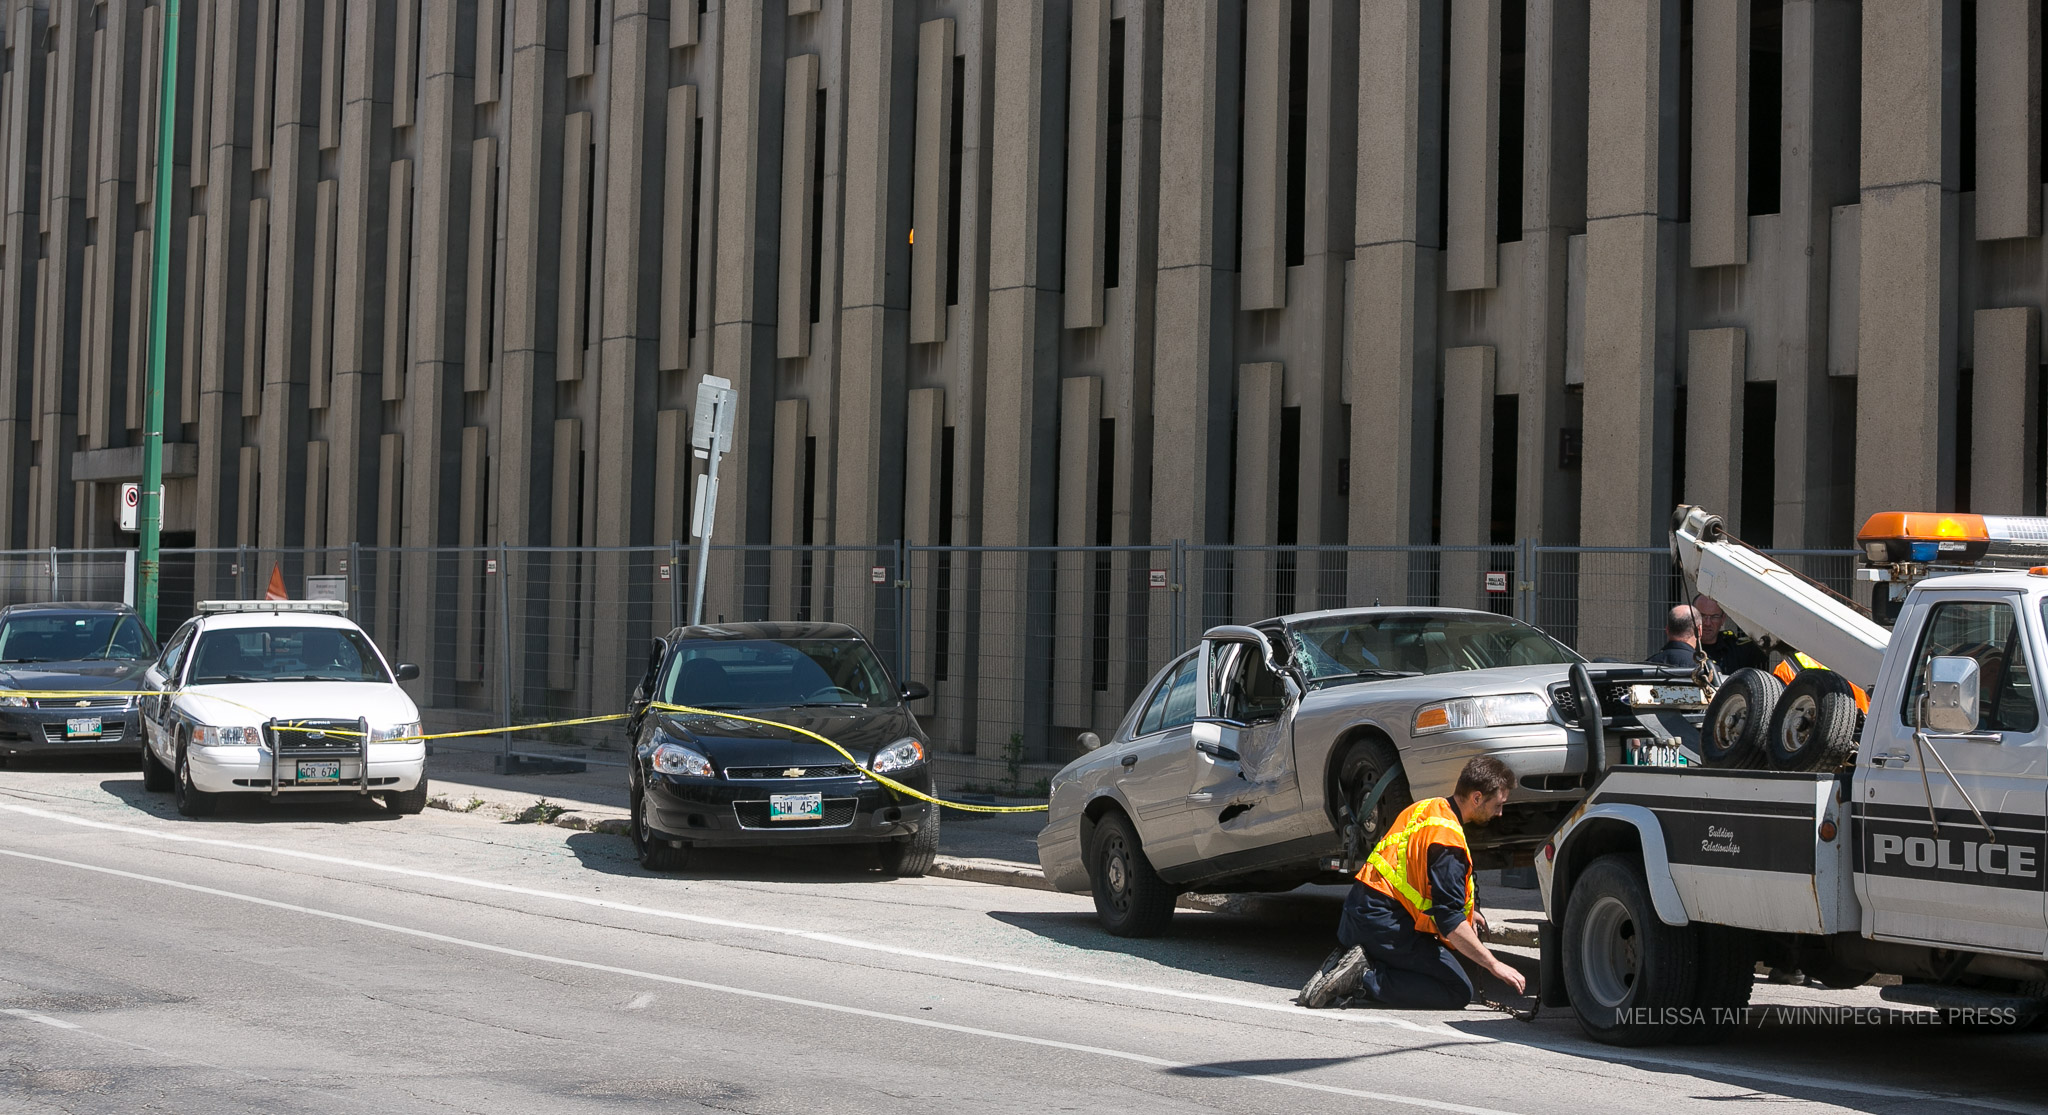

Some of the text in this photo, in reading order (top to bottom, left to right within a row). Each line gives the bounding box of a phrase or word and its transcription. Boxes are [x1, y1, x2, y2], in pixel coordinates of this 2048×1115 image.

[300, 767, 338, 777] GCR 679
[773, 800, 820, 814] FHW 453
[1708, 825, 1734, 842] Building
[1701, 839, 1740, 856] Relationships
[1873, 833, 2037, 878] POLICE
